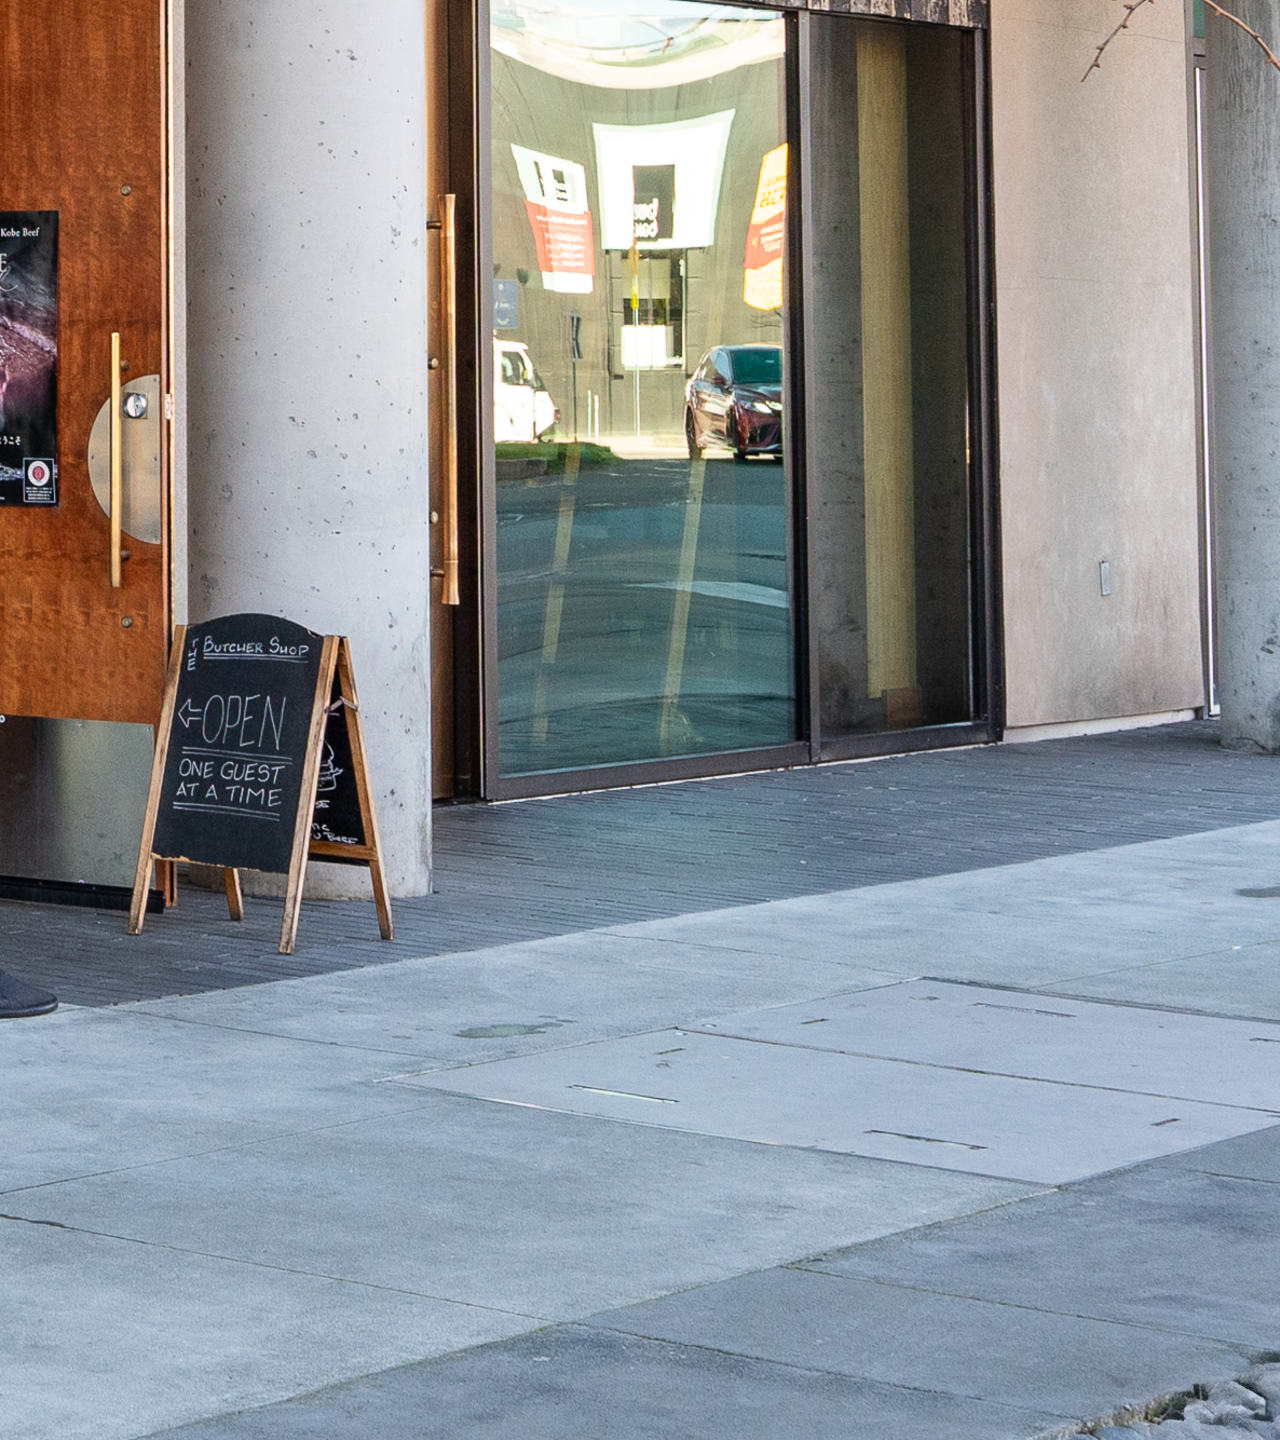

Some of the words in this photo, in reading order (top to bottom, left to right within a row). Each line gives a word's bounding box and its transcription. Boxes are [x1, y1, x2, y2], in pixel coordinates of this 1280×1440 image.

[1, 227, 21, 237] Kobe
[22, 227, 40, 237] Beef
[187, 639, 198, 671] THE
[203, 635, 263, 654] BUTCHER
[269, 637, 309, 656] SHOP
[202, 694, 287, 751] OPEN
[179, 758, 214, 779] ONE
[220, 761, 286, 785] GUEST
[175, 782, 200, 797] AT
[205, 784, 218, 800] A
[226, 785, 283, 807] TIME
